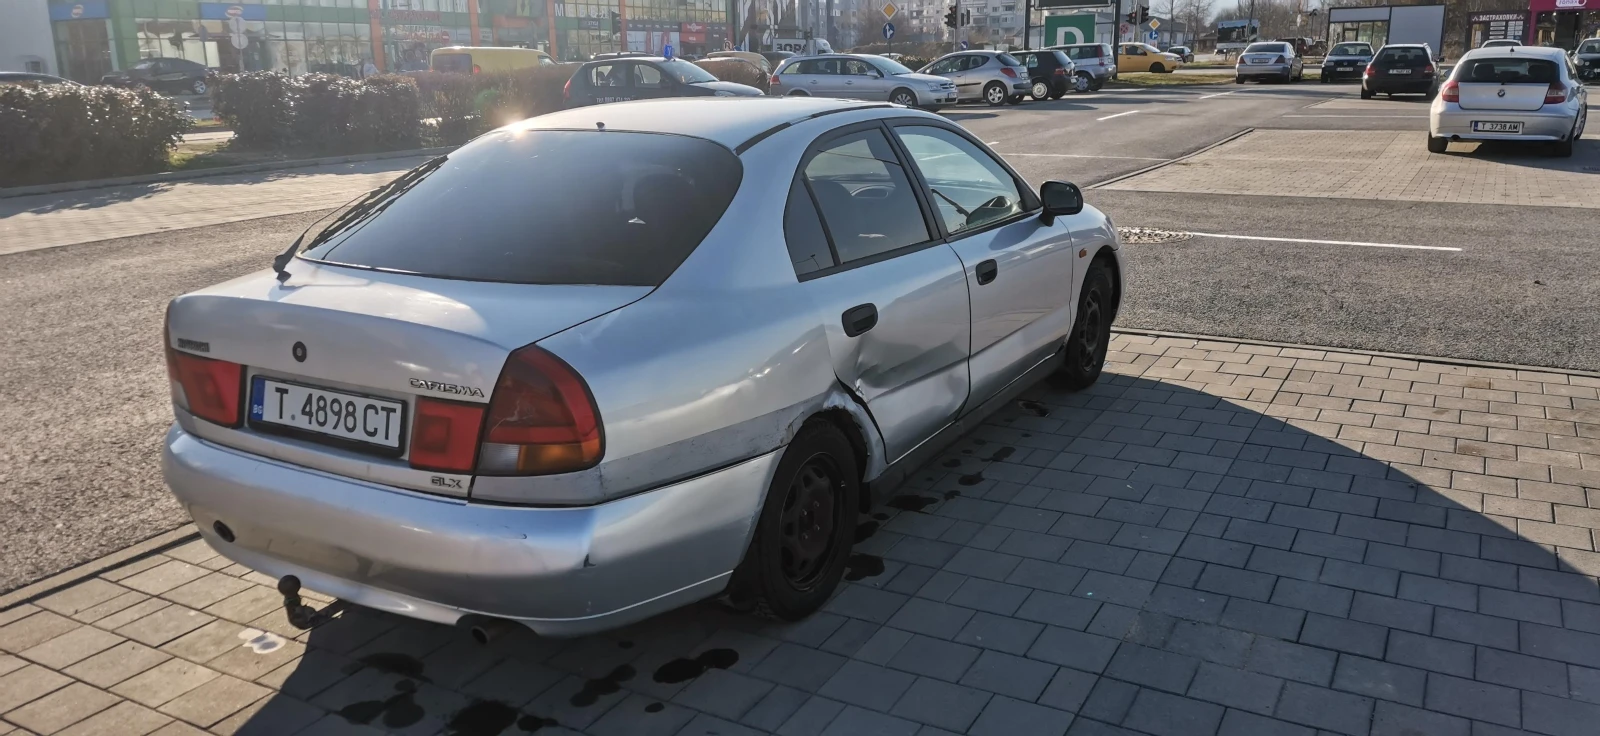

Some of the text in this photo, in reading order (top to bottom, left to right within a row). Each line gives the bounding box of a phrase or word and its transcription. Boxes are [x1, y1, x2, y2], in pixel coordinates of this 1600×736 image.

[408, 377, 486, 398] CARISMA
[252, 404, 263, 415] BG
[275, 387, 397, 440] T 4898 CT
[430, 475, 463, 488] GLX
